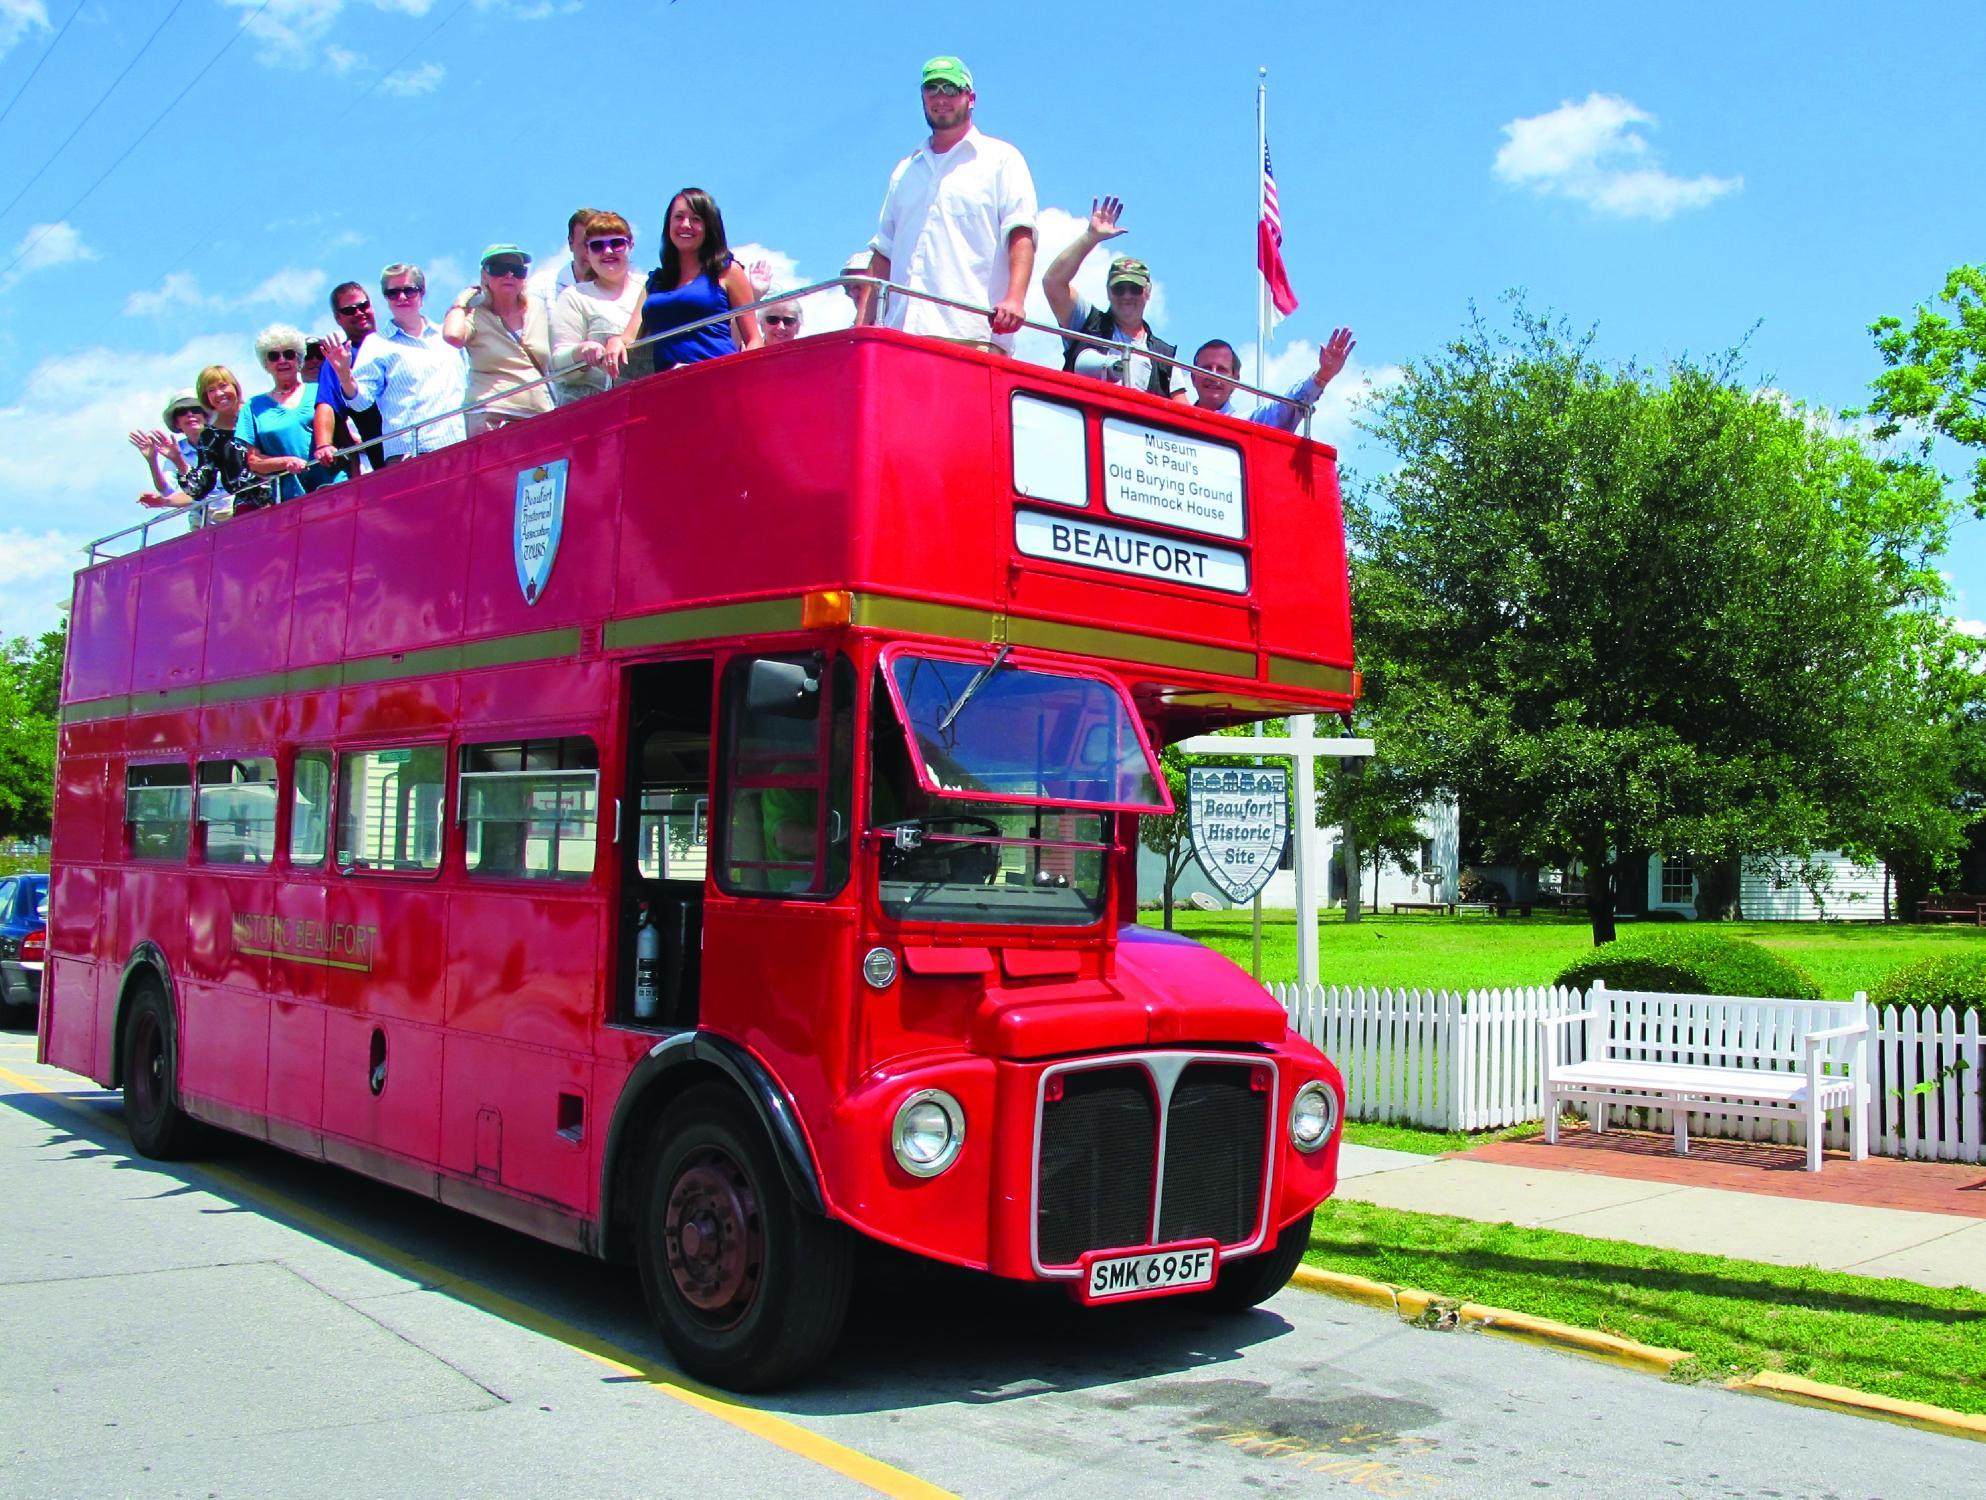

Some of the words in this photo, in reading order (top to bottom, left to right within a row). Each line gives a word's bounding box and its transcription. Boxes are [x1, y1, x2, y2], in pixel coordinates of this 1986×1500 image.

[1145, 433, 1197, 457] Museum
[1145, 452, 1159, 466] St
[1162, 456, 1199, 476] Paul's
[1109, 463, 1132, 481] Old
[1136, 469, 1185, 496] Burying
[1188, 482, 1233, 504] Ground
[1120, 485, 1183, 512] Hammock
[1187, 501, 1225, 521] House
[1052, 524, 1209, 578] BEAUFORT
[1204, 799, 1273, 821] Beaufort
[1207, 823, 1271, 842] Historic
[1224, 847, 1255, 865] Site
[231, 911, 292, 951] HISTORIC
[295, 919, 377, 972] BEAUFORT
[1094, 1261, 1140, 1291] SMK
[1146, 1252, 1209, 1283] 695F
